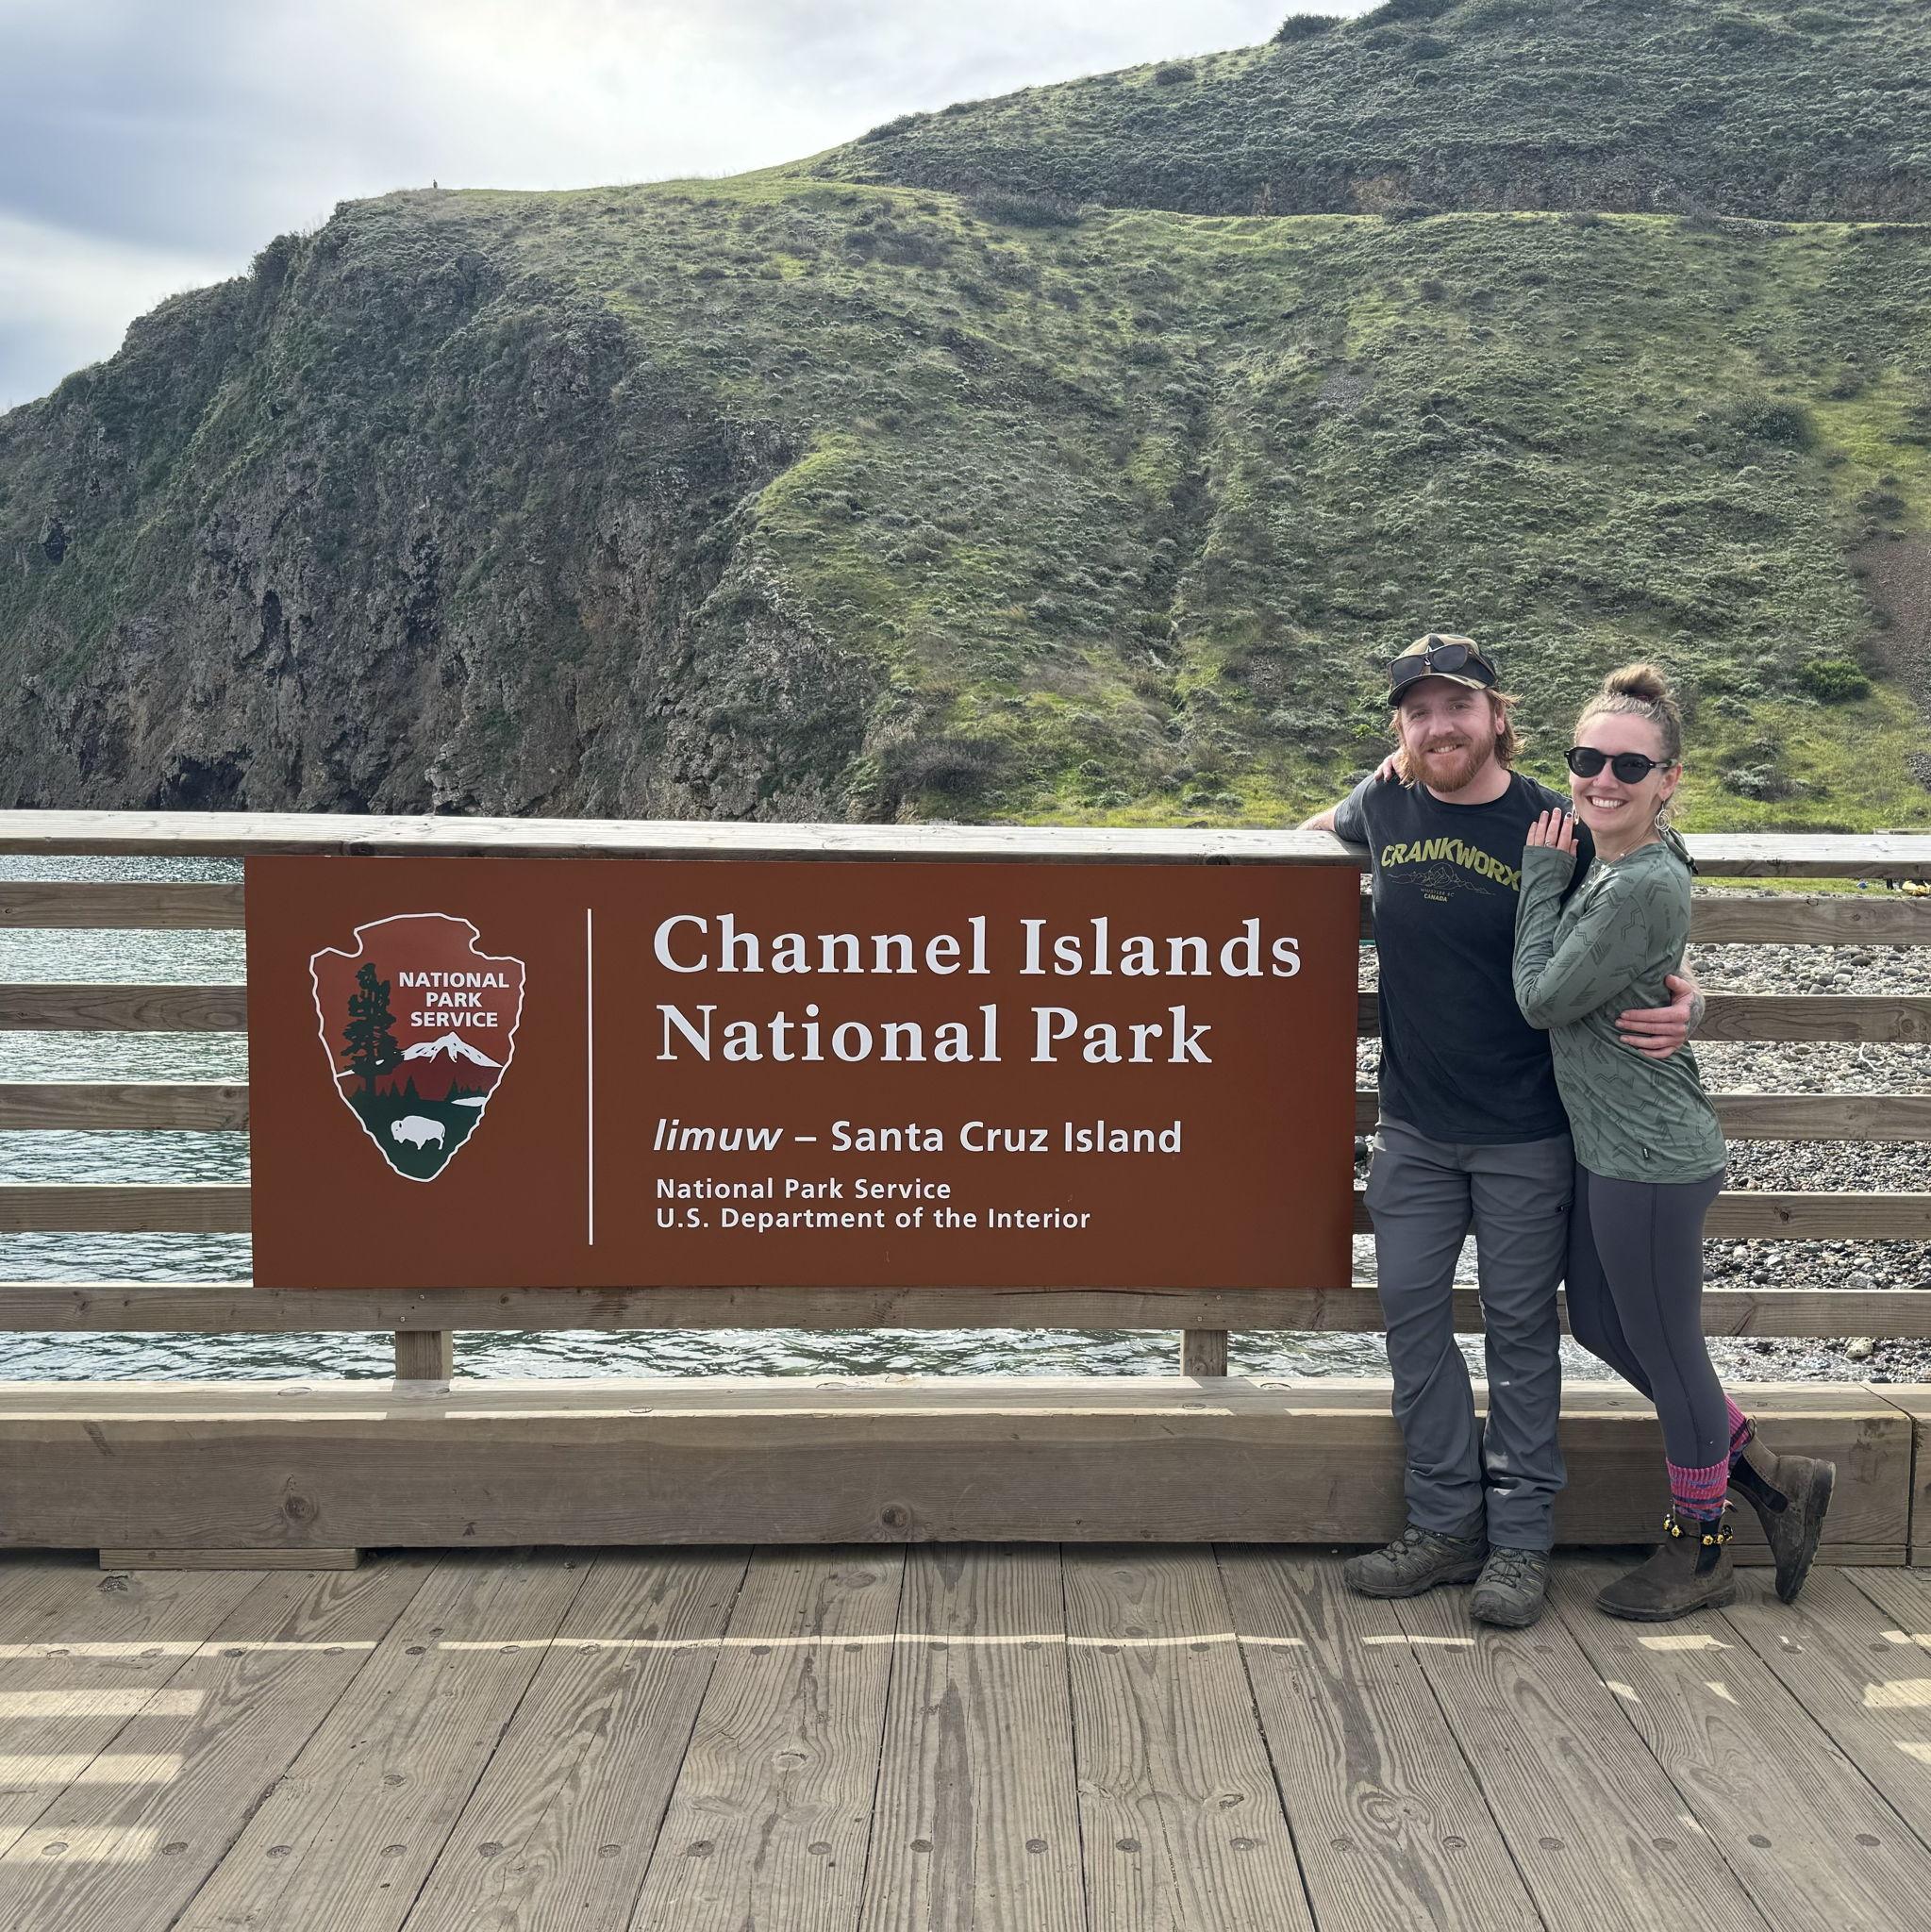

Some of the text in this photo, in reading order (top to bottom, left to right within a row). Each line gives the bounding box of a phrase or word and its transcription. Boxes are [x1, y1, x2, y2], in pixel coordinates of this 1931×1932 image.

[1381, 837, 1522, 891] CRANKWORX
[1423, 892, 1448, 902] CANADA
[653, 912, 1301, 977] Channel Islands
[399, 972, 510, 989] NATIONAL
[425, 991, 483, 1008] PARK
[410, 1010, 498, 1027] SERVICE
[656, 1003, 1213, 1064] National Park
[653, 1118, 784, 1152] limuw
[831, 1120, 943, 1152] Santa
[959, 1121, 1049, 1153] Cruz
[1064, 1120, 1181, 1153] Island
[657, 1176, 951, 1200] National Park Service
[657, 1206, 1090, 1233] U.S. Department of the Interior
